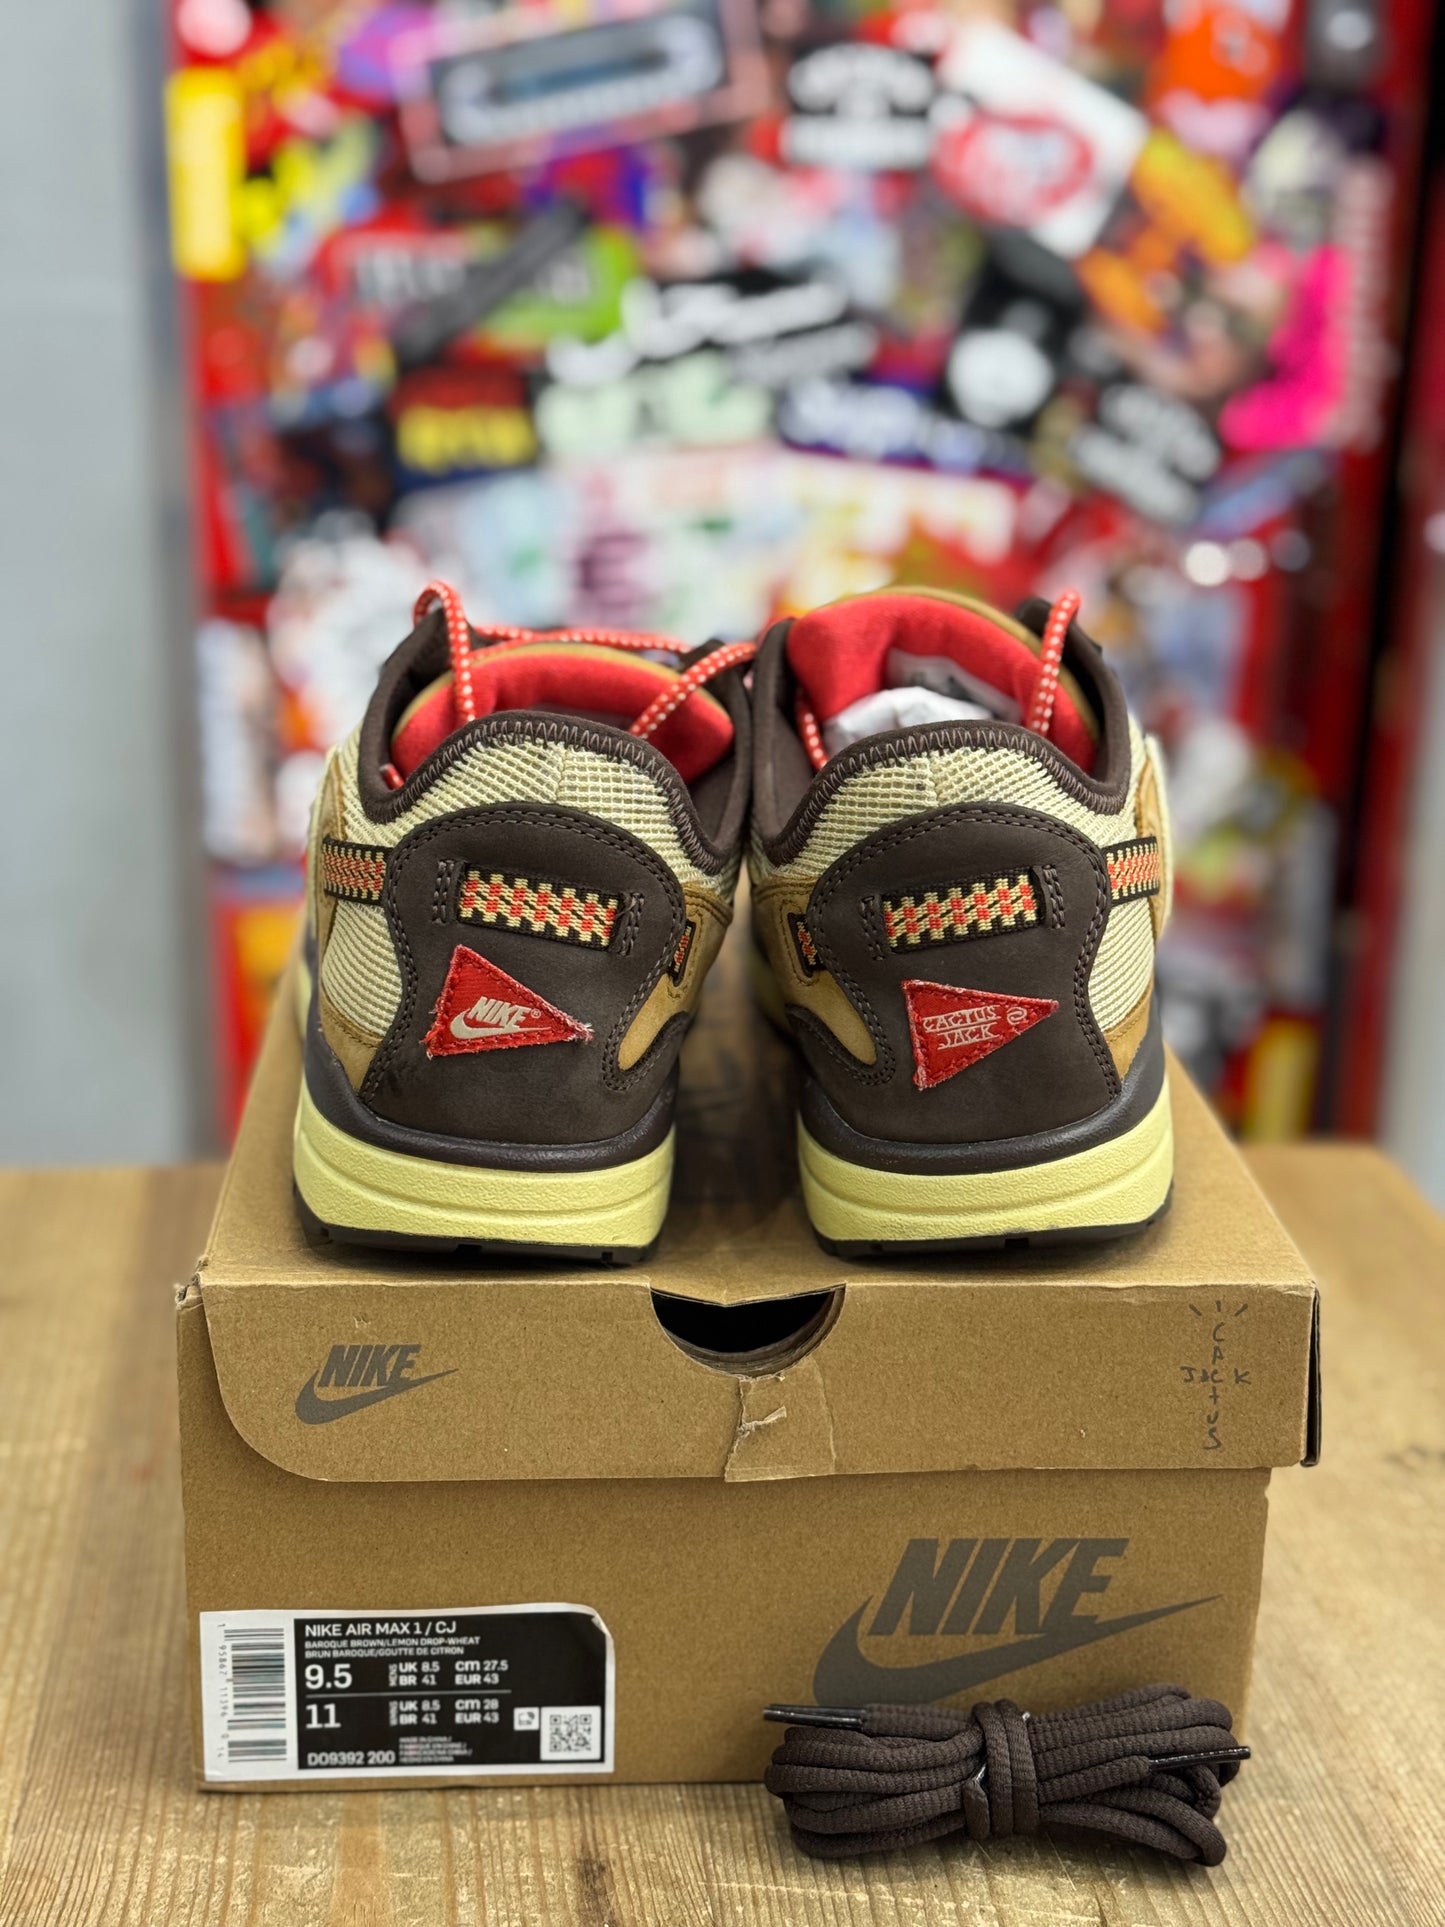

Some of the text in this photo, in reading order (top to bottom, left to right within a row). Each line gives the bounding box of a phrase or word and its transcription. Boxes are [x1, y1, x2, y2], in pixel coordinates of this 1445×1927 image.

[467, 996, 532, 1029] NIKE
[922, 1004, 1001, 1033] CACTUS
[937, 1021, 1001, 1050] JACK
[318, 1344, 422, 1388] NIKE
[867, 1538, 1130, 1636] NIKE
[305, 1623, 342, 1637] NIKE
[345, 1623, 372, 1636] AIR
[375, 1622, 410, 1635] MAX
[414, 1622, 422, 1634] 1
[435, 1620, 457, 1634] CJ
[304, 1640, 348, 1650] BAROQUE
[420, 1636, 480, 1646] DROP-WHEAT
[304, 1649, 331, 1659] BRUN
[416, 1647, 429, 1656] DE
[430, 1646, 465, 1655] CITRON
[399, 1660, 509, 1673] UK 8.5 cm 27.5
[304, 1663, 353, 1689] 9.5
[399, 1673, 500, 1686] BR 41 EUR 43
[399, 1700, 418, 1711] UK
[421, 1699, 440, 1711] 8.5
[483, 1698, 499, 1710] 28
[305, 1703, 342, 1729] 11
[421, 1713, 437, 1725] 41
[455, 1712, 481, 1723] EUR
[483, 1711, 499, 1723] 43
[367, 1750, 396, 1764] 200
